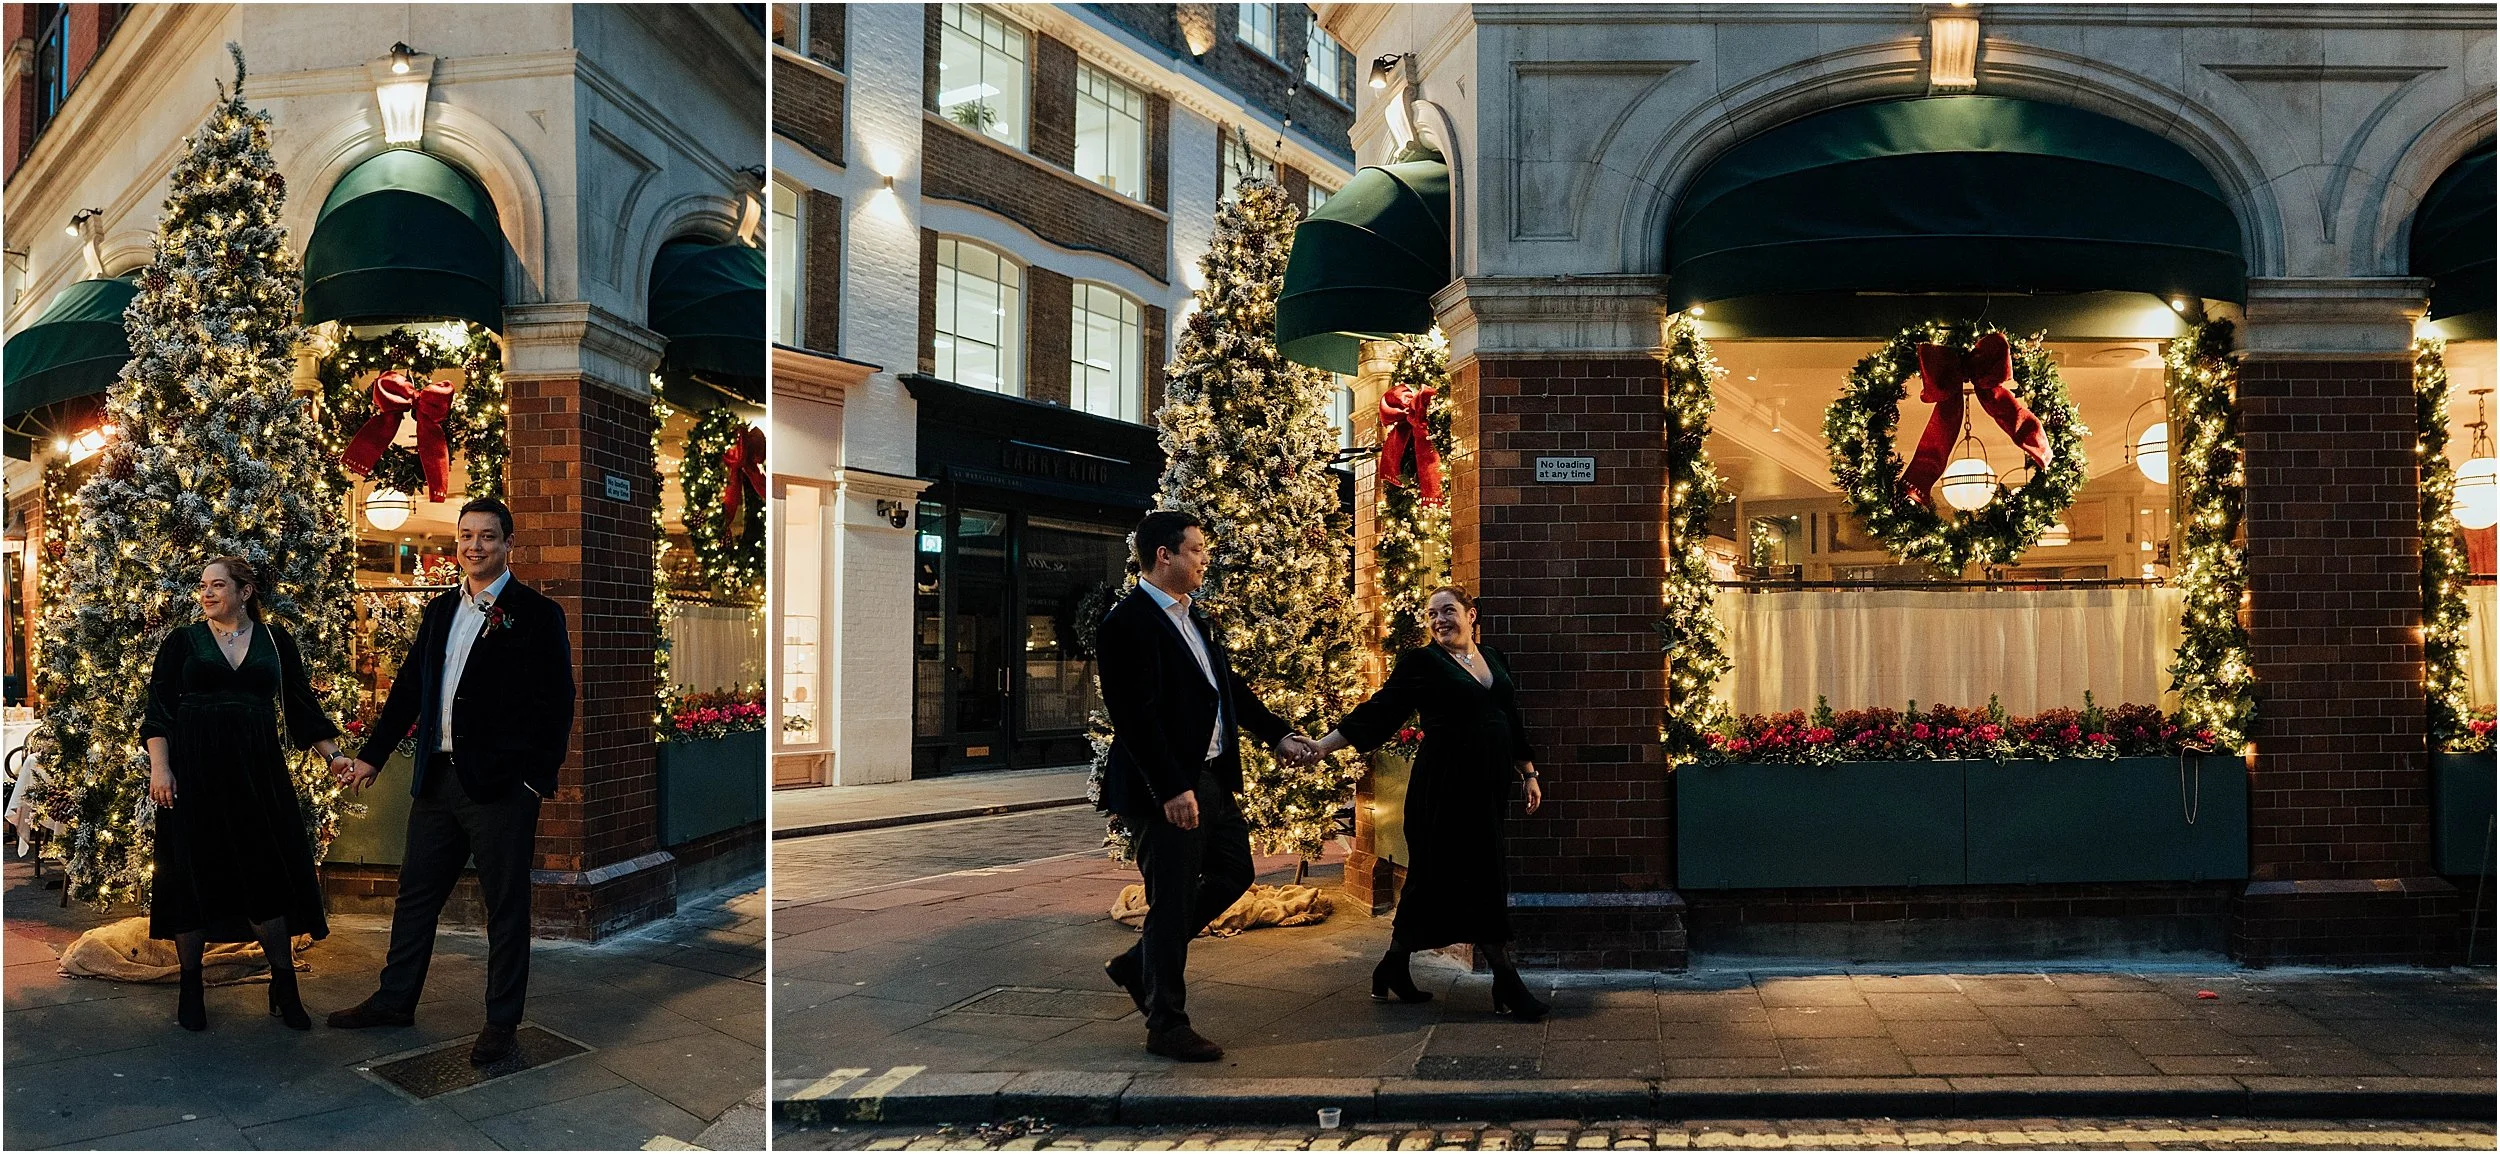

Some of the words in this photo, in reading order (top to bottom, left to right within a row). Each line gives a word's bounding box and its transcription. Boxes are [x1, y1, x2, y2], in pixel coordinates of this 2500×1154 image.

[1002, 447, 1061, 476] LARRY
[1069, 459, 1108, 483] KING
[1540, 461, 1554, 469] No
[1556, 461, 1590, 470] loading
[1539, 470, 1549, 478] at
[1551, 471, 1568, 479] any
[1571, 470, 1591, 478] time
